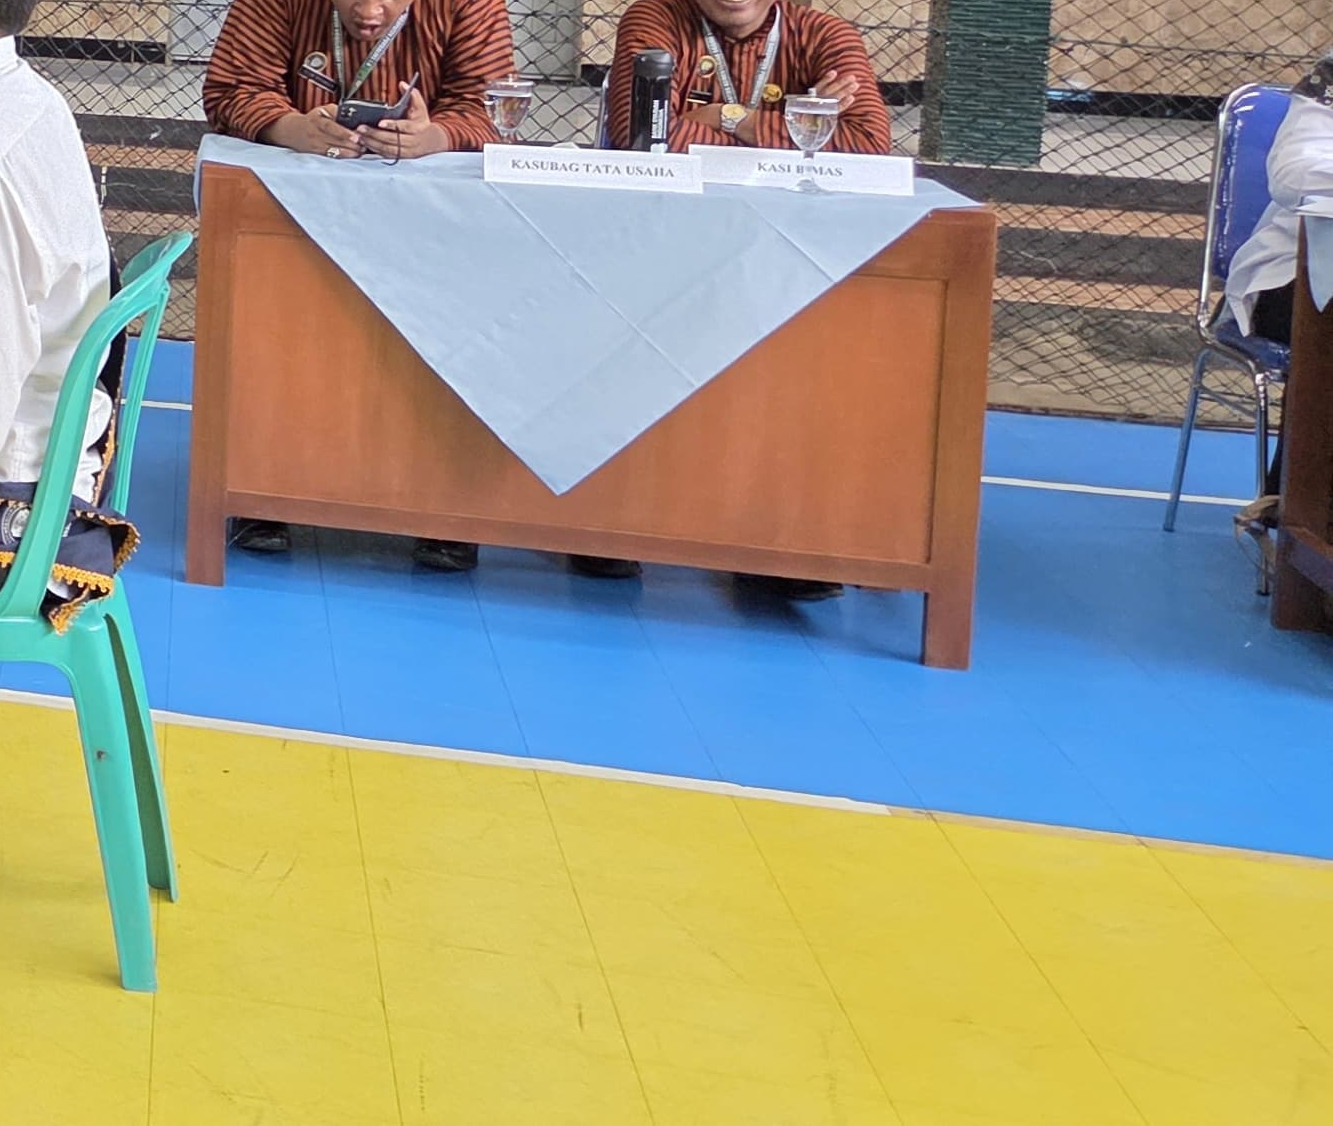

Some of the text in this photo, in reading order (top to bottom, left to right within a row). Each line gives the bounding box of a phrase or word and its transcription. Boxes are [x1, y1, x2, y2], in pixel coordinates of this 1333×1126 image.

[511, 159, 675, 178] KASUBAG TATA USAHA
[757, 161, 843, 177] KASI BMAS
